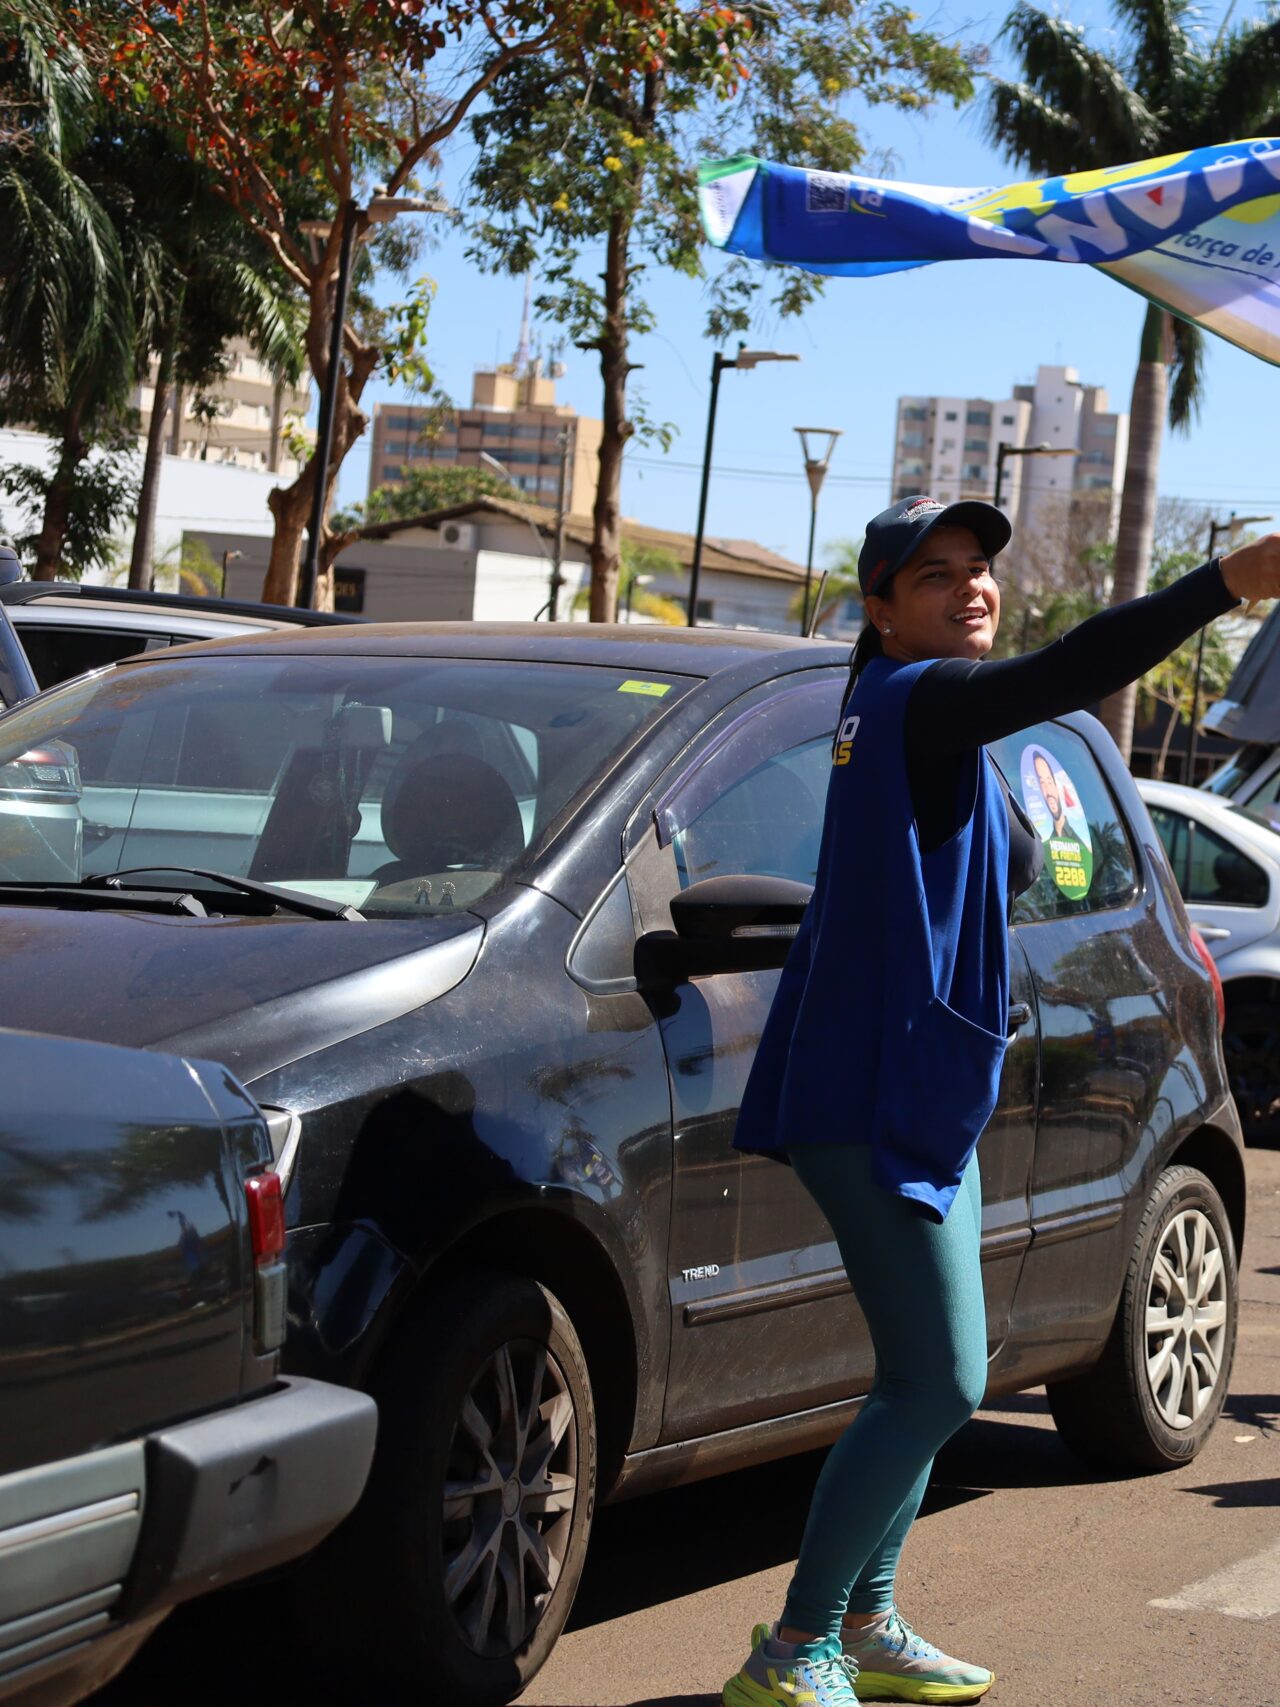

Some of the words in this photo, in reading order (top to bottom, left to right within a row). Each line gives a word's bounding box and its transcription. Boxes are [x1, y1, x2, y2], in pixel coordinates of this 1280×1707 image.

[1241, 242, 1274, 267] de
[1049, 839, 1081, 854] HERMANO
[1055, 866, 1087, 887] 2288
[681, 1264, 720, 1280] TREND
